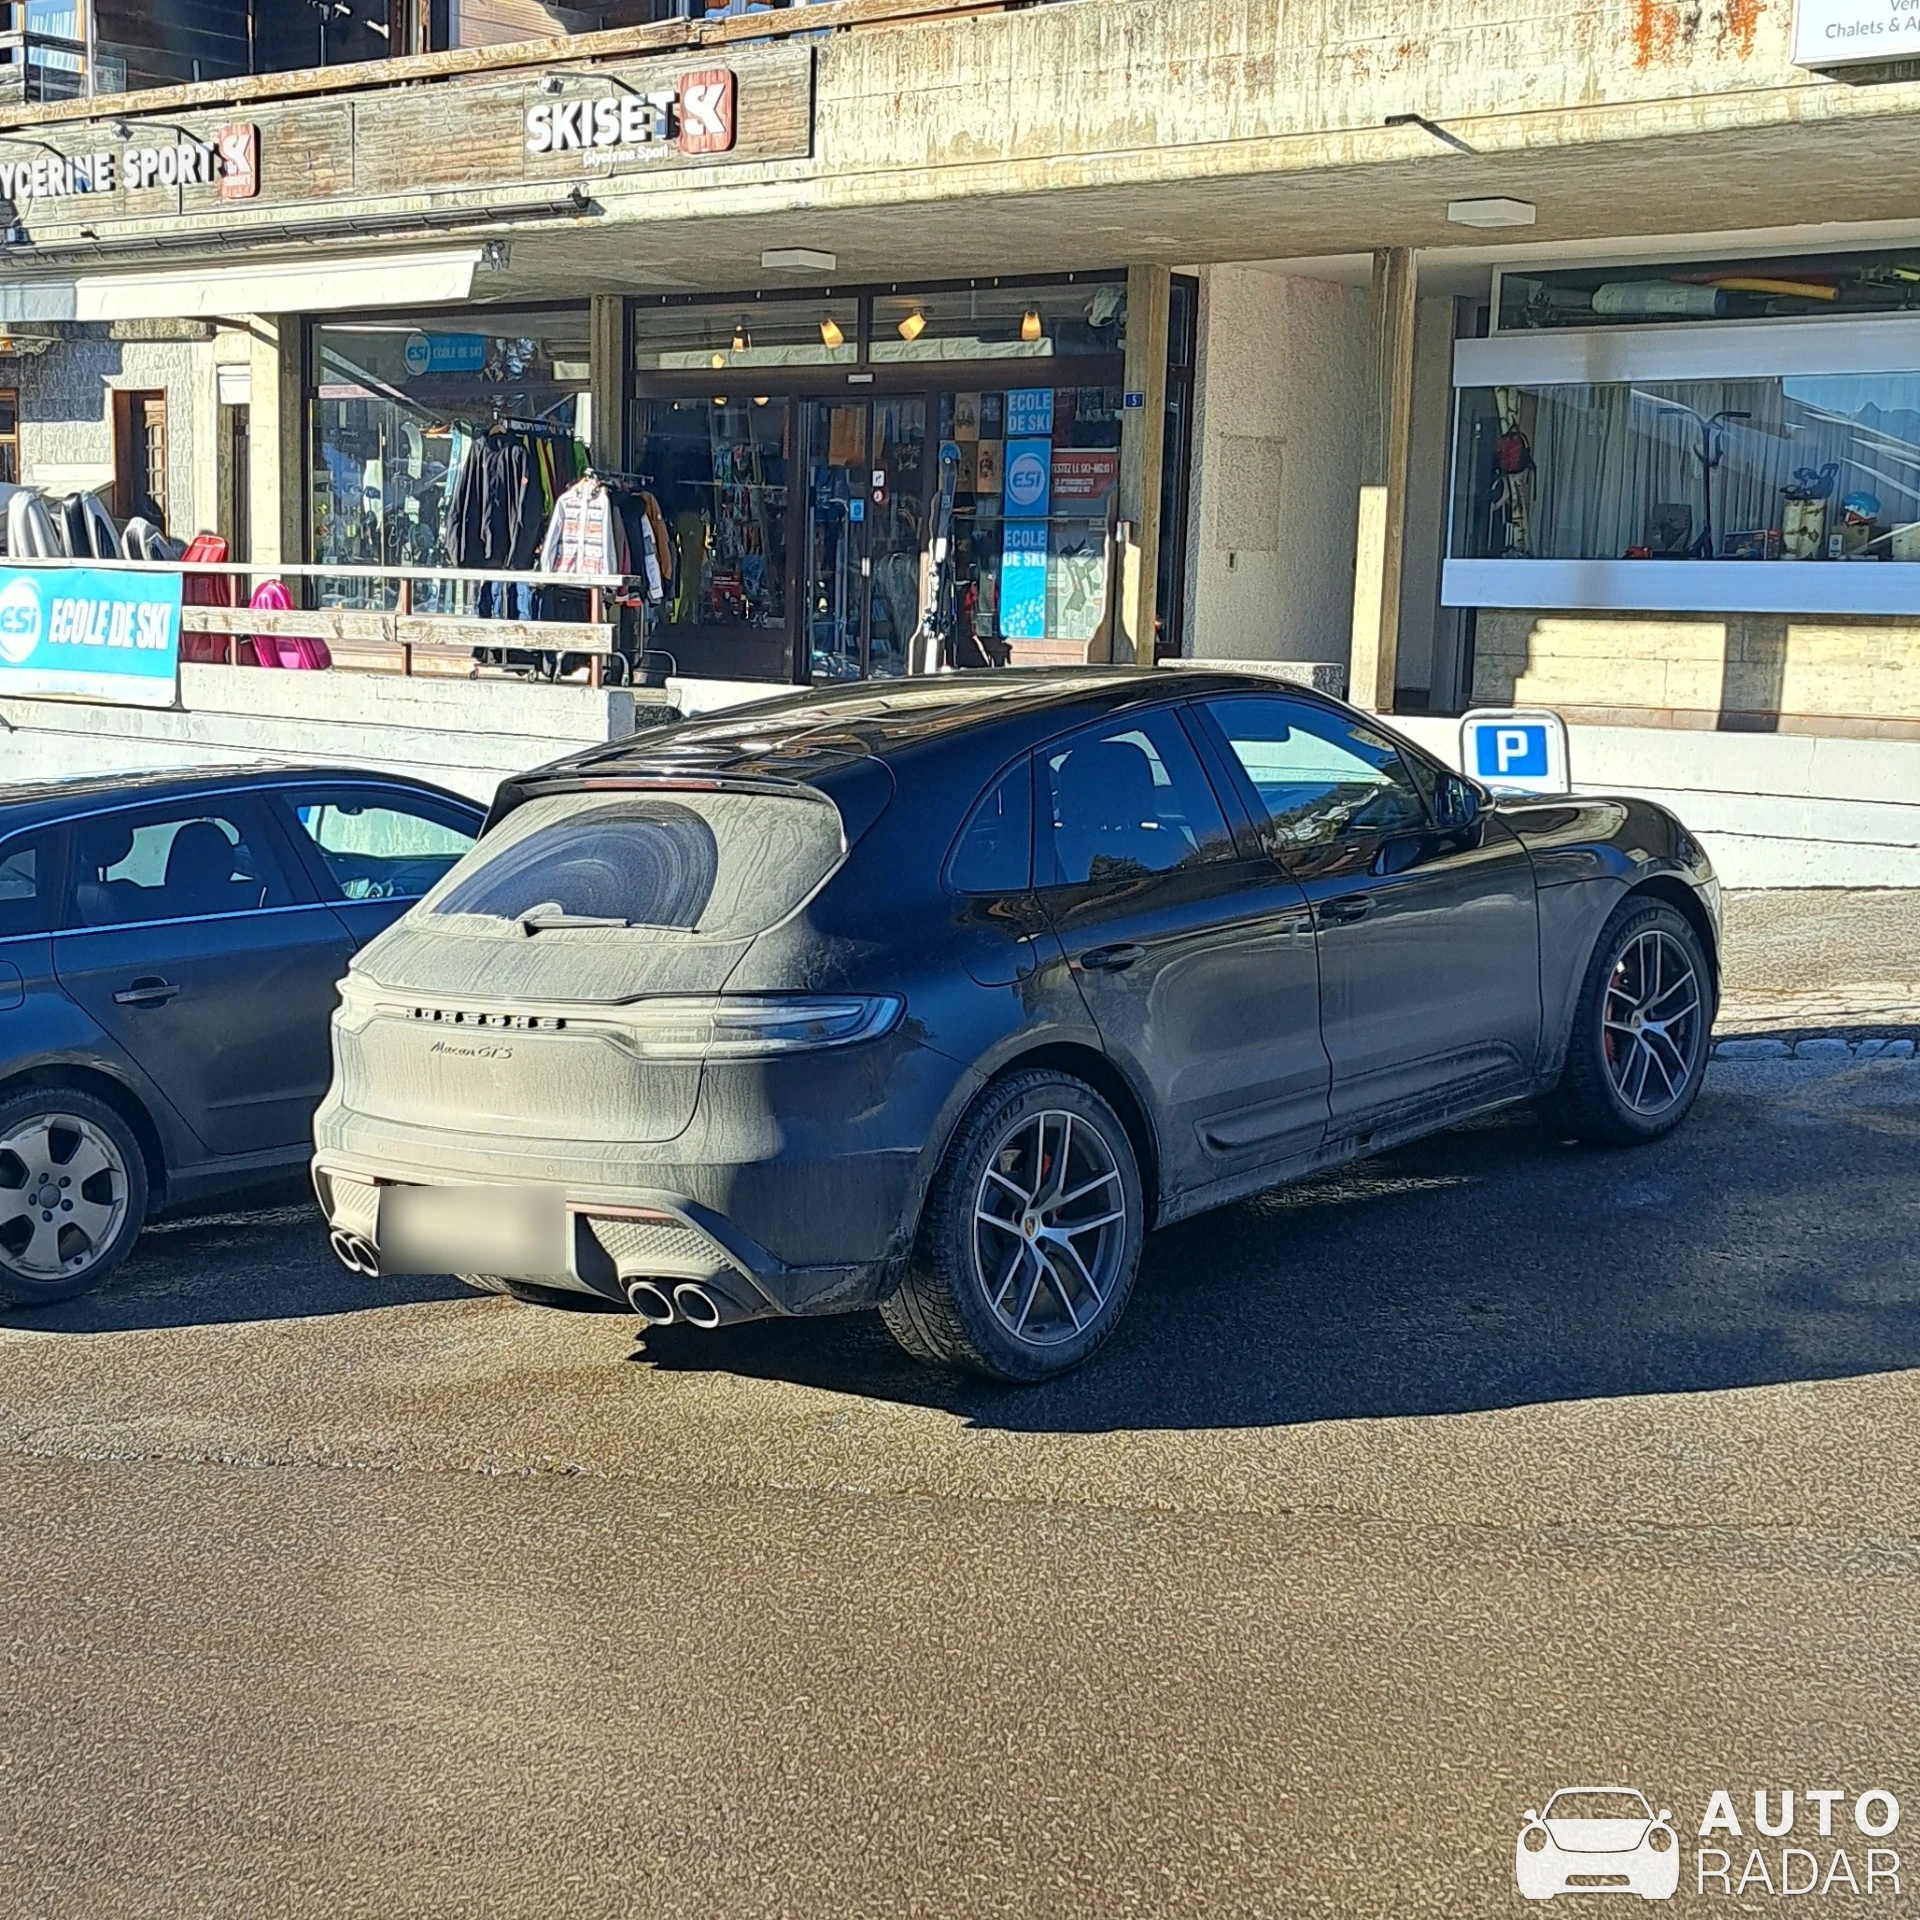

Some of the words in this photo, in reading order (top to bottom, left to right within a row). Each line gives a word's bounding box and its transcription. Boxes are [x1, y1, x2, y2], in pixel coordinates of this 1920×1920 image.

[1825, 20, 1884, 39] Chalets
[1888, 17, 1900, 32] &
[526, 91, 676, 152] SKISET
[636, 144, 668, 162] Sport
[123, 142, 215, 188] SPORT
[1009, 392, 1051, 411] ECOLE
[1009, 415, 1024, 431] DE
[1028, 413, 1051, 431] SKI
[1005, 530, 1046, 547] ECOLE
[1002, 551, 1021, 567] DE
[1023, 551, 1047, 567] SKI
[48, 597, 110, 646] ECOLE
[108, 600, 137, 648] DE
[136, 602, 173, 650] SKI
[1497, 730, 1528, 772] P
[430, 1041, 475, 1057] Macan
[478, 1045, 513, 1059] GTS
